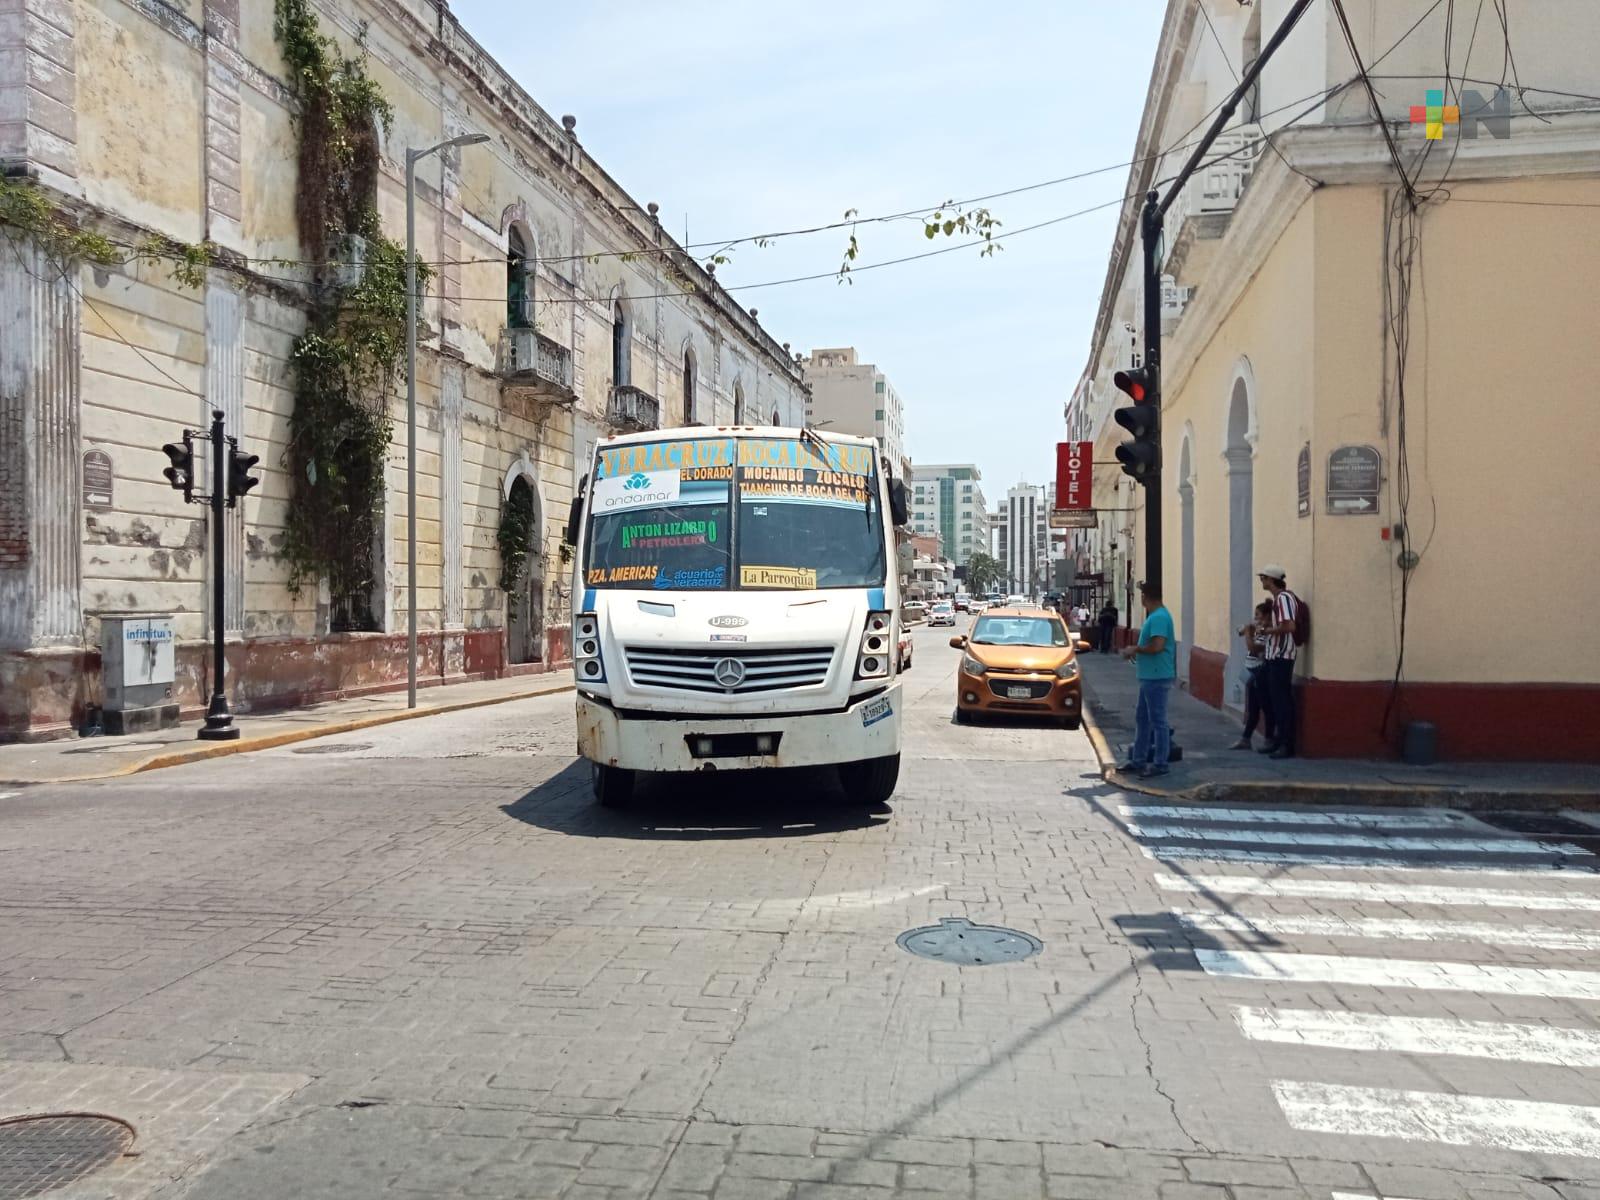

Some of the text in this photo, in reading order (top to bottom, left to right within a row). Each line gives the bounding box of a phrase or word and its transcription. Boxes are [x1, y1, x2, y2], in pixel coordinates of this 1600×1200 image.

[603, 441, 727, 477] VERACRUZ
[738, 440, 789, 466] BOCA
[681, 467, 733, 480] EL DORADO
[744, 467, 865, 489] MOCAMBO ZOCALO
[605, 492, 671, 507] andamar
[740, 483, 788, 496] TIANGUIS
[790, 484, 803, 496] DE
[806, 485, 833, 499] BOCA
[835, 488, 852, 501] DEL
[622, 523, 661, 549] ANTON
[664, 520, 717, 543] LIZARDO
[588, 565, 658, 584] PZA. AMERICAS
[674, 568, 714, 580] acuario
[744, 570, 814, 587] La Parroquia
[674, 579, 722, 588] veracruz
